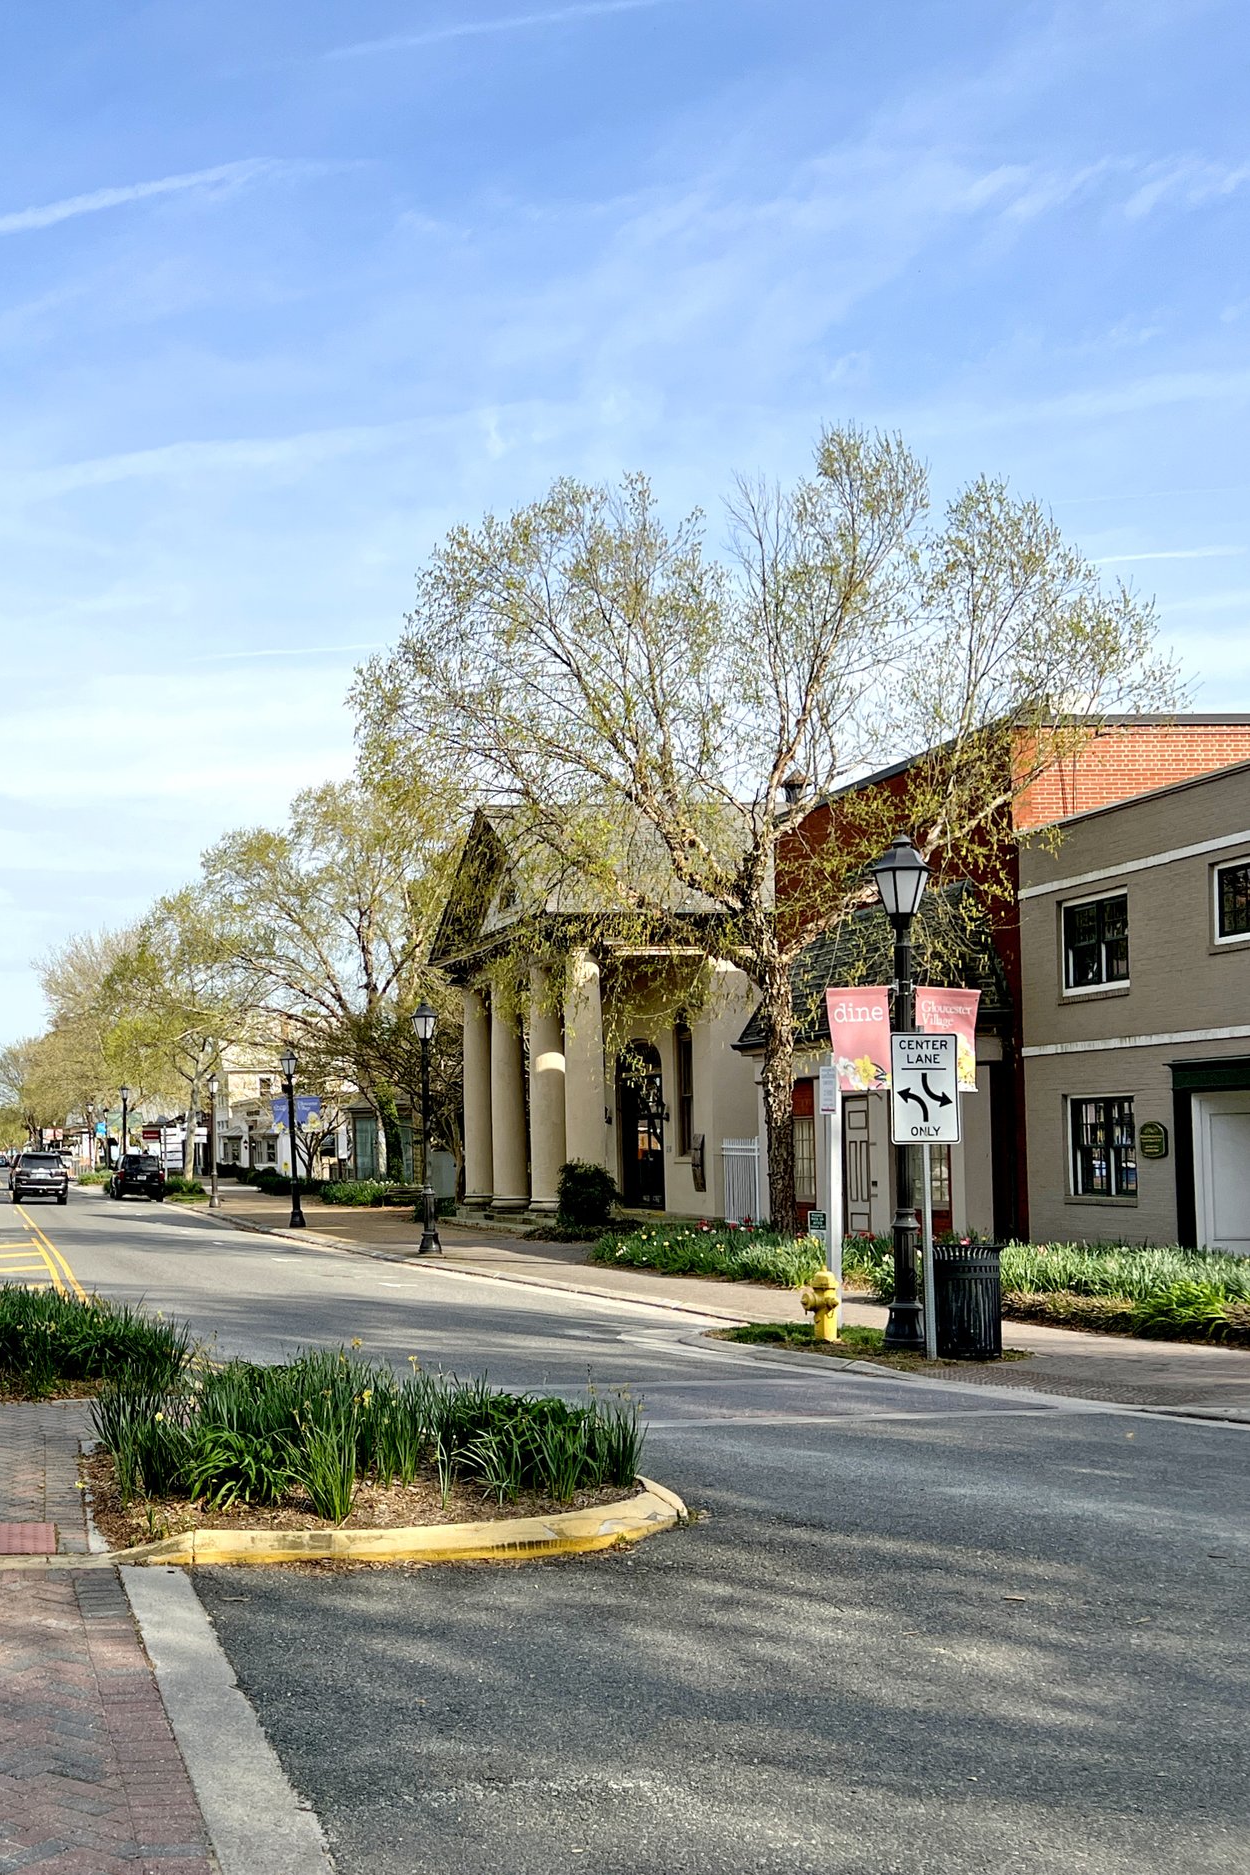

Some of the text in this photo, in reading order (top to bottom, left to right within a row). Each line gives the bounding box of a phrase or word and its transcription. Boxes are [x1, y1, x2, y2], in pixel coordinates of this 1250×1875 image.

[834, 1003, 884, 1023] dine
[921, 1000, 973, 1015] Gloucester
[922, 1013, 954, 1028] Village
[899, 1039, 948, 1050] CENTER
[906, 1053, 940, 1064] LANE
[910, 1126, 941, 1137] ONLY
